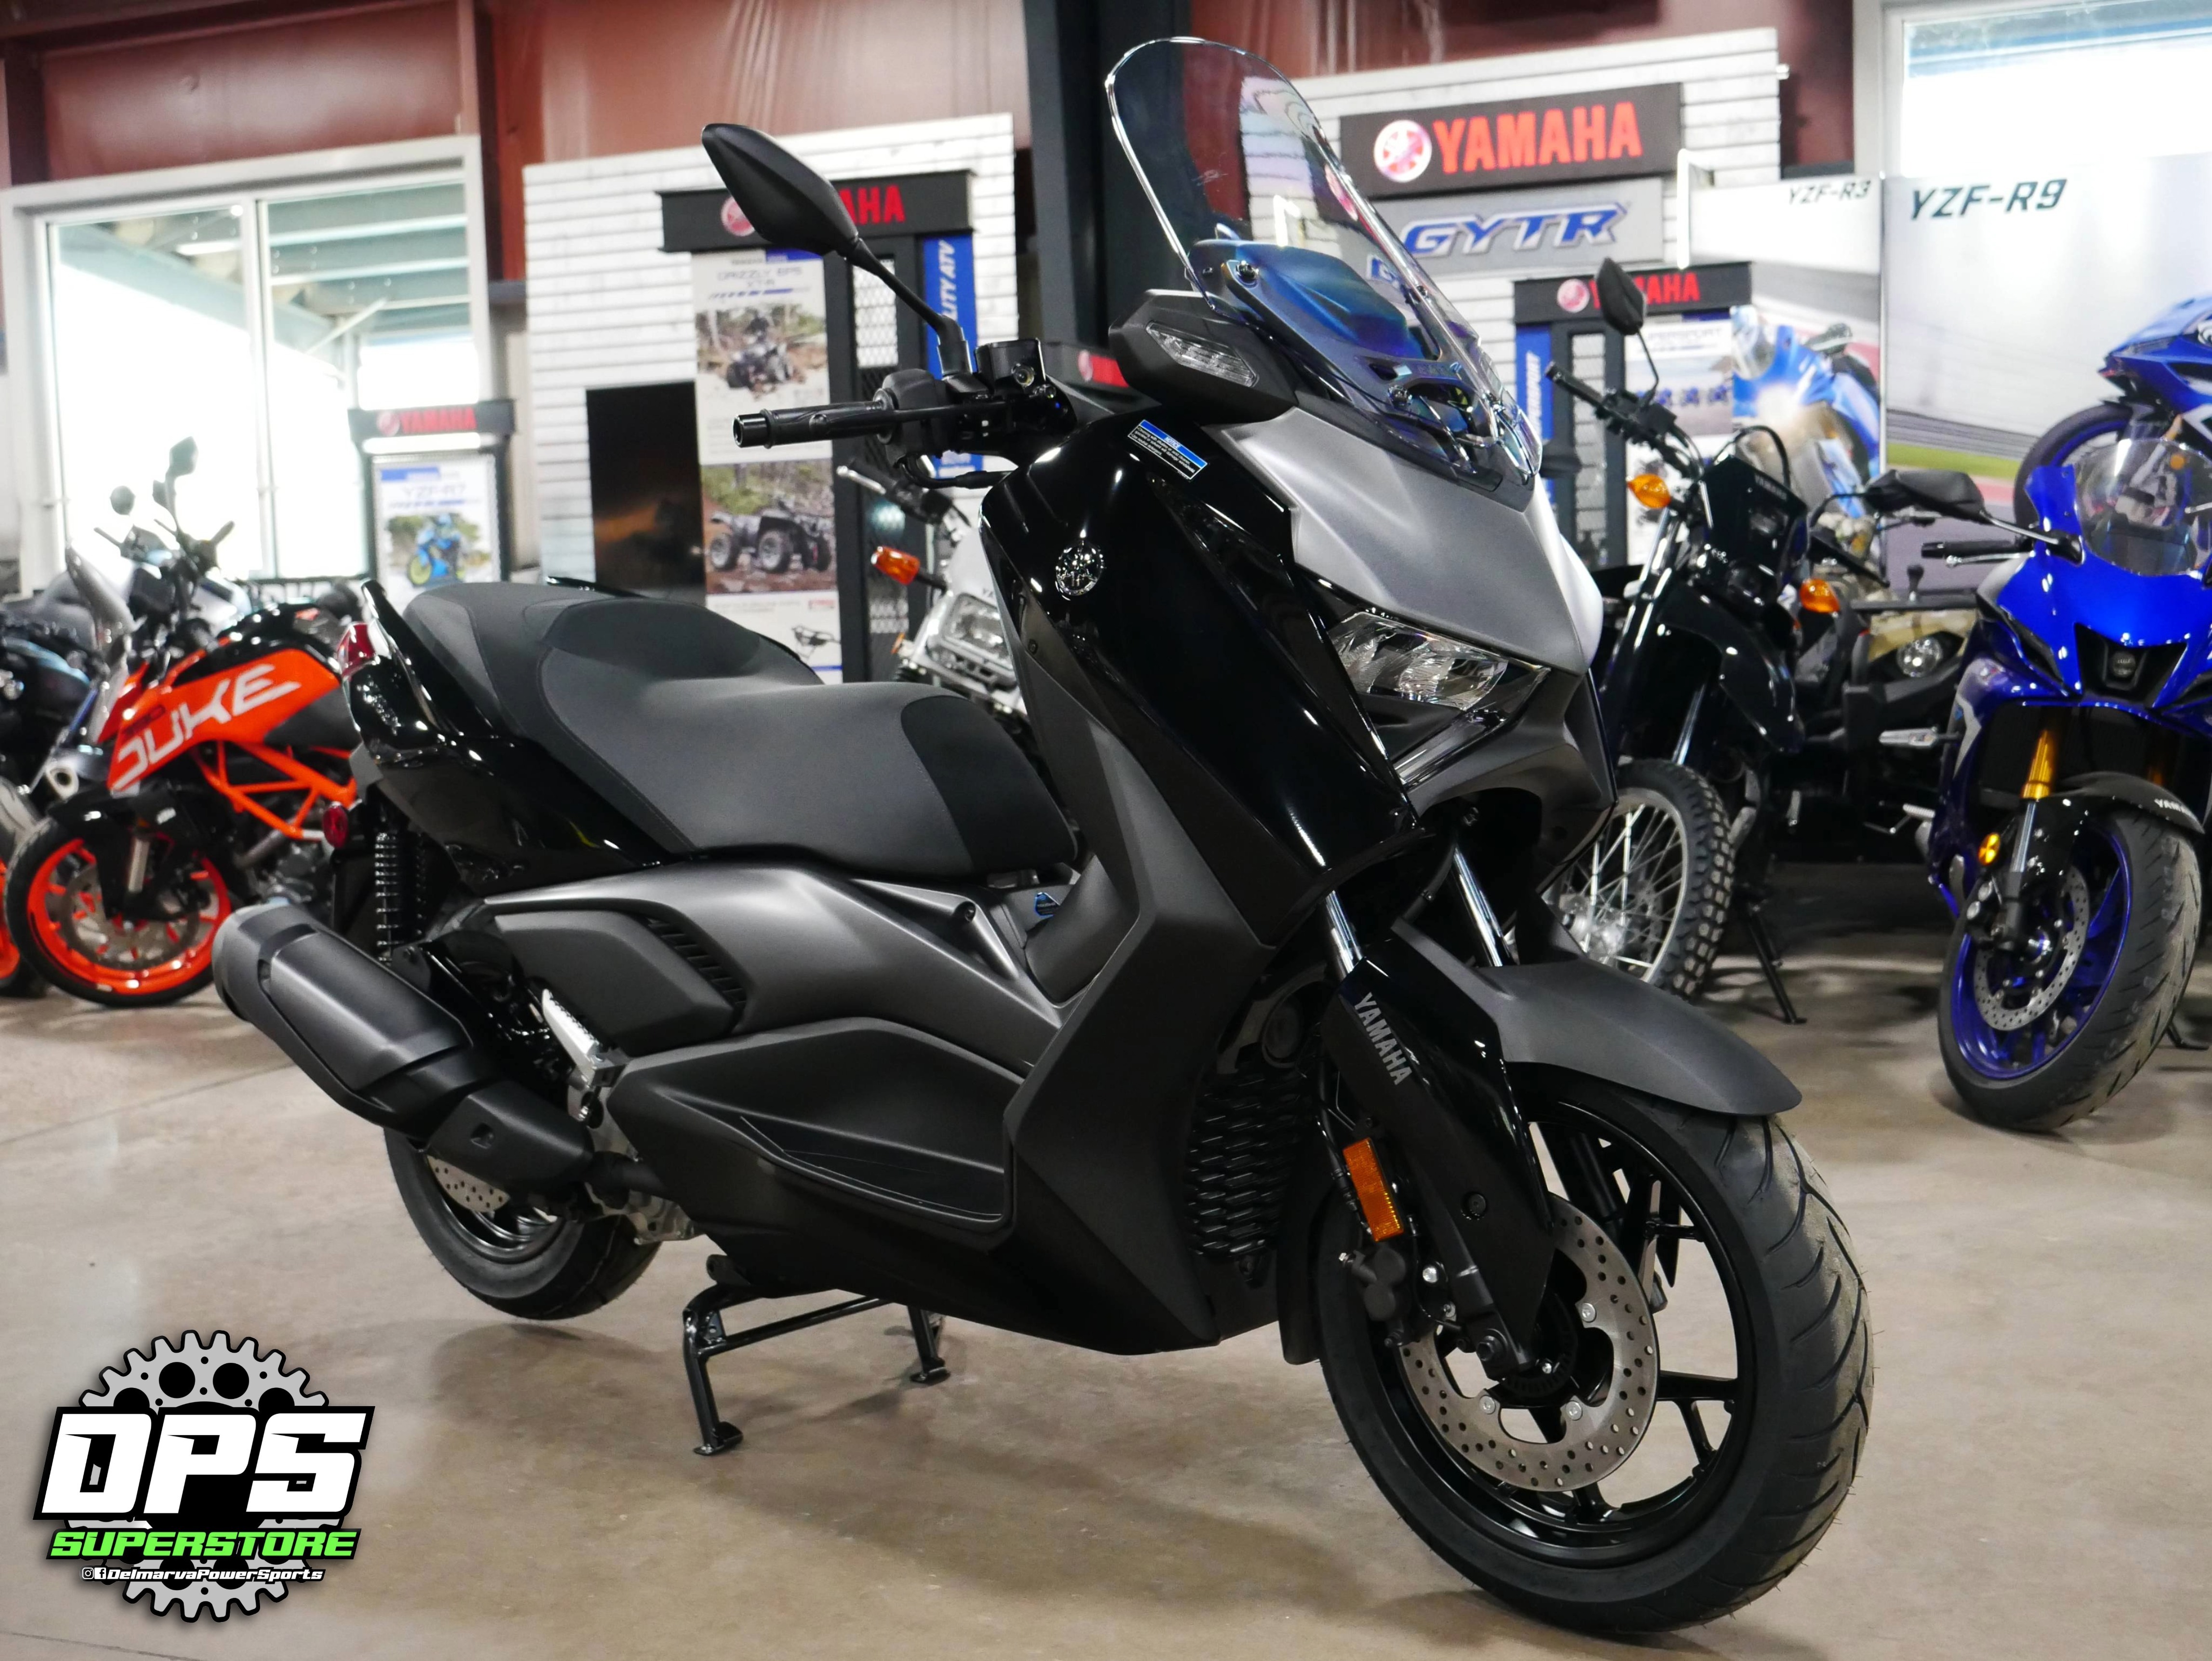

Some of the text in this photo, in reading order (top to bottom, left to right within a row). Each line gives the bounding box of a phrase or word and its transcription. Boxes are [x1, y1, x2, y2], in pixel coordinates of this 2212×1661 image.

[1434, 102, 1642, 174] YAMAHA
[839, 184, 906, 225] AHA
[1909, 178, 2067, 220] YZF-R9
[1399, 202, 1624, 258] GYTR
[399, 407, 477, 434] YAMAHA
[1164, 436, 1181, 449] NOTICE
[110, 663, 301, 791] DUKE
[1354, 992, 1412, 1085] YAMAHA
